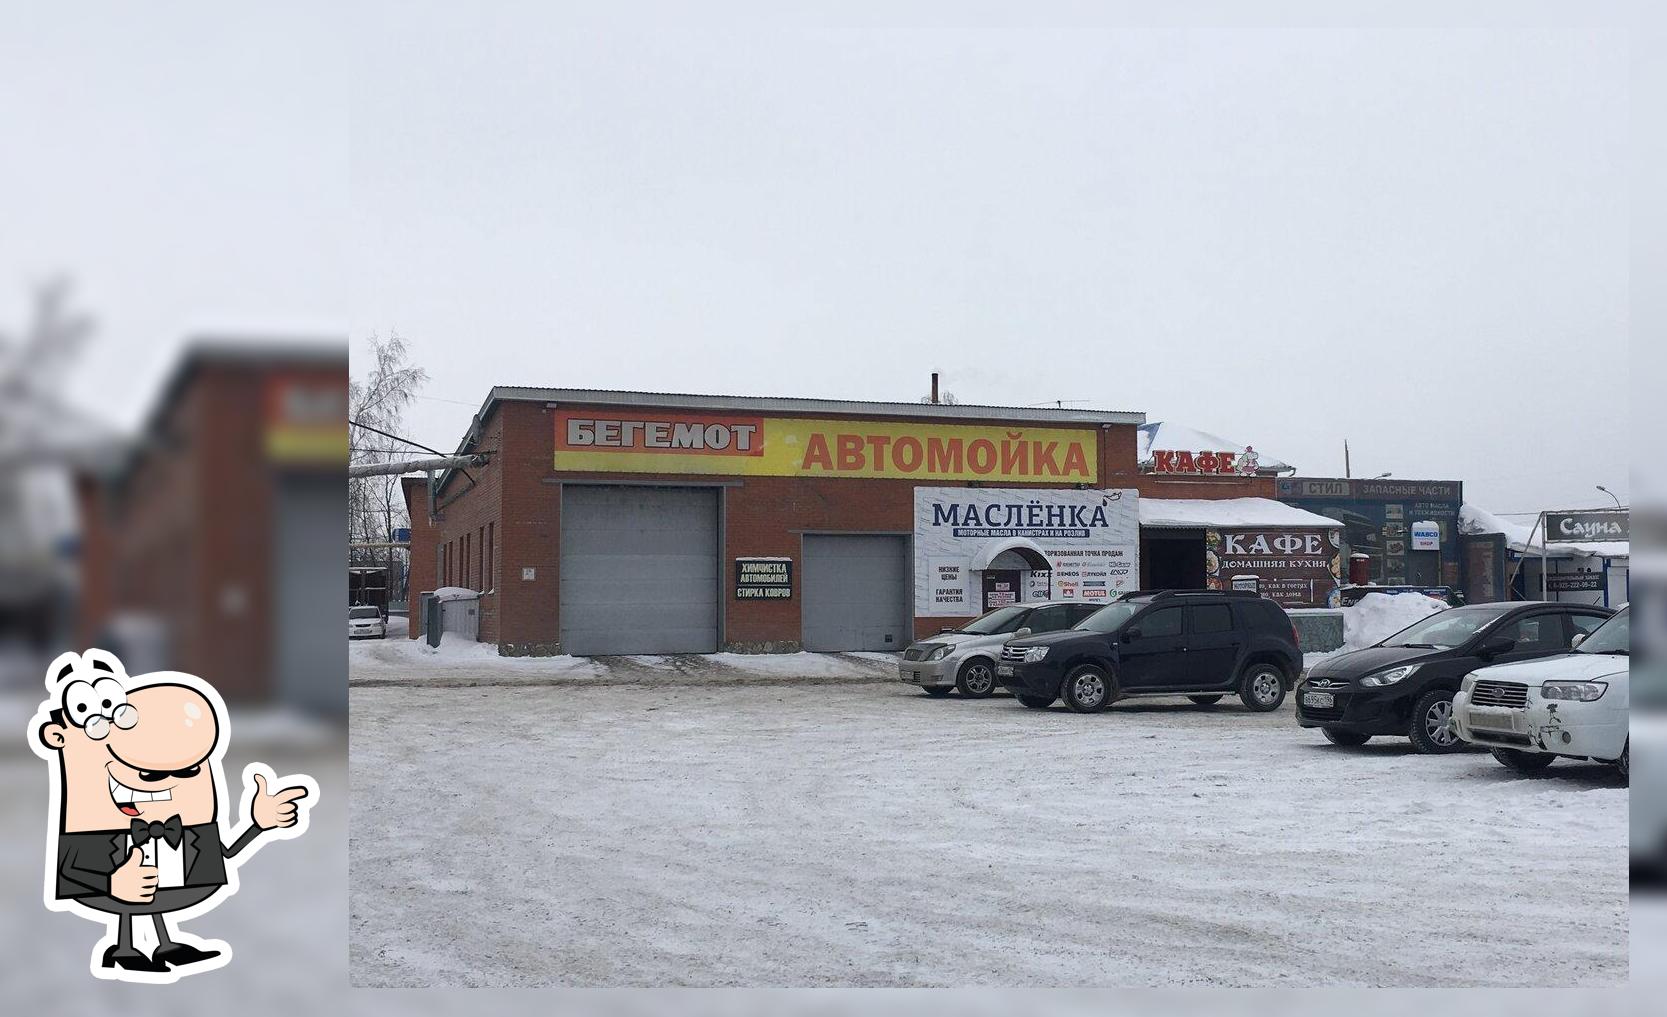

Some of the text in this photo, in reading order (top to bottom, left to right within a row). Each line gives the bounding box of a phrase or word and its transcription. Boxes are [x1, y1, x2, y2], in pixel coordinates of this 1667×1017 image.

[567, 418, 756, 450] БЕГЕМОТ
[801, 431, 1090, 477] АВТОМОЙКА
[1152, 450, 1236, 475] КАФЕ
[1308, 482, 1343, 495] СТИЛ
[1362, 484, 1451, 496] ЗАПАСНЫЕ ЧАСТИ
[932, 500, 1110, 528] МАСЛЁНКА
[957, 529, 990, 537] МОТОРНЫЕ
[991, 529, 1011, 537] МАСЛА
[1560, 518, 1622, 538] Сауна
[1224, 534, 1323, 555] КАФЕ
[741, 563, 787, 573] ХИМЧИСТКА
[1221, 560, 1326, 569] ДОМАШНЯЯ КУХНЯ
[740, 573, 788, 583] АВТОМОБИЛЕЙ
[737, 588, 791, 597] СТИРКА КОВРОВ
[936, 588, 963, 596] ГАРАНТИЯ
